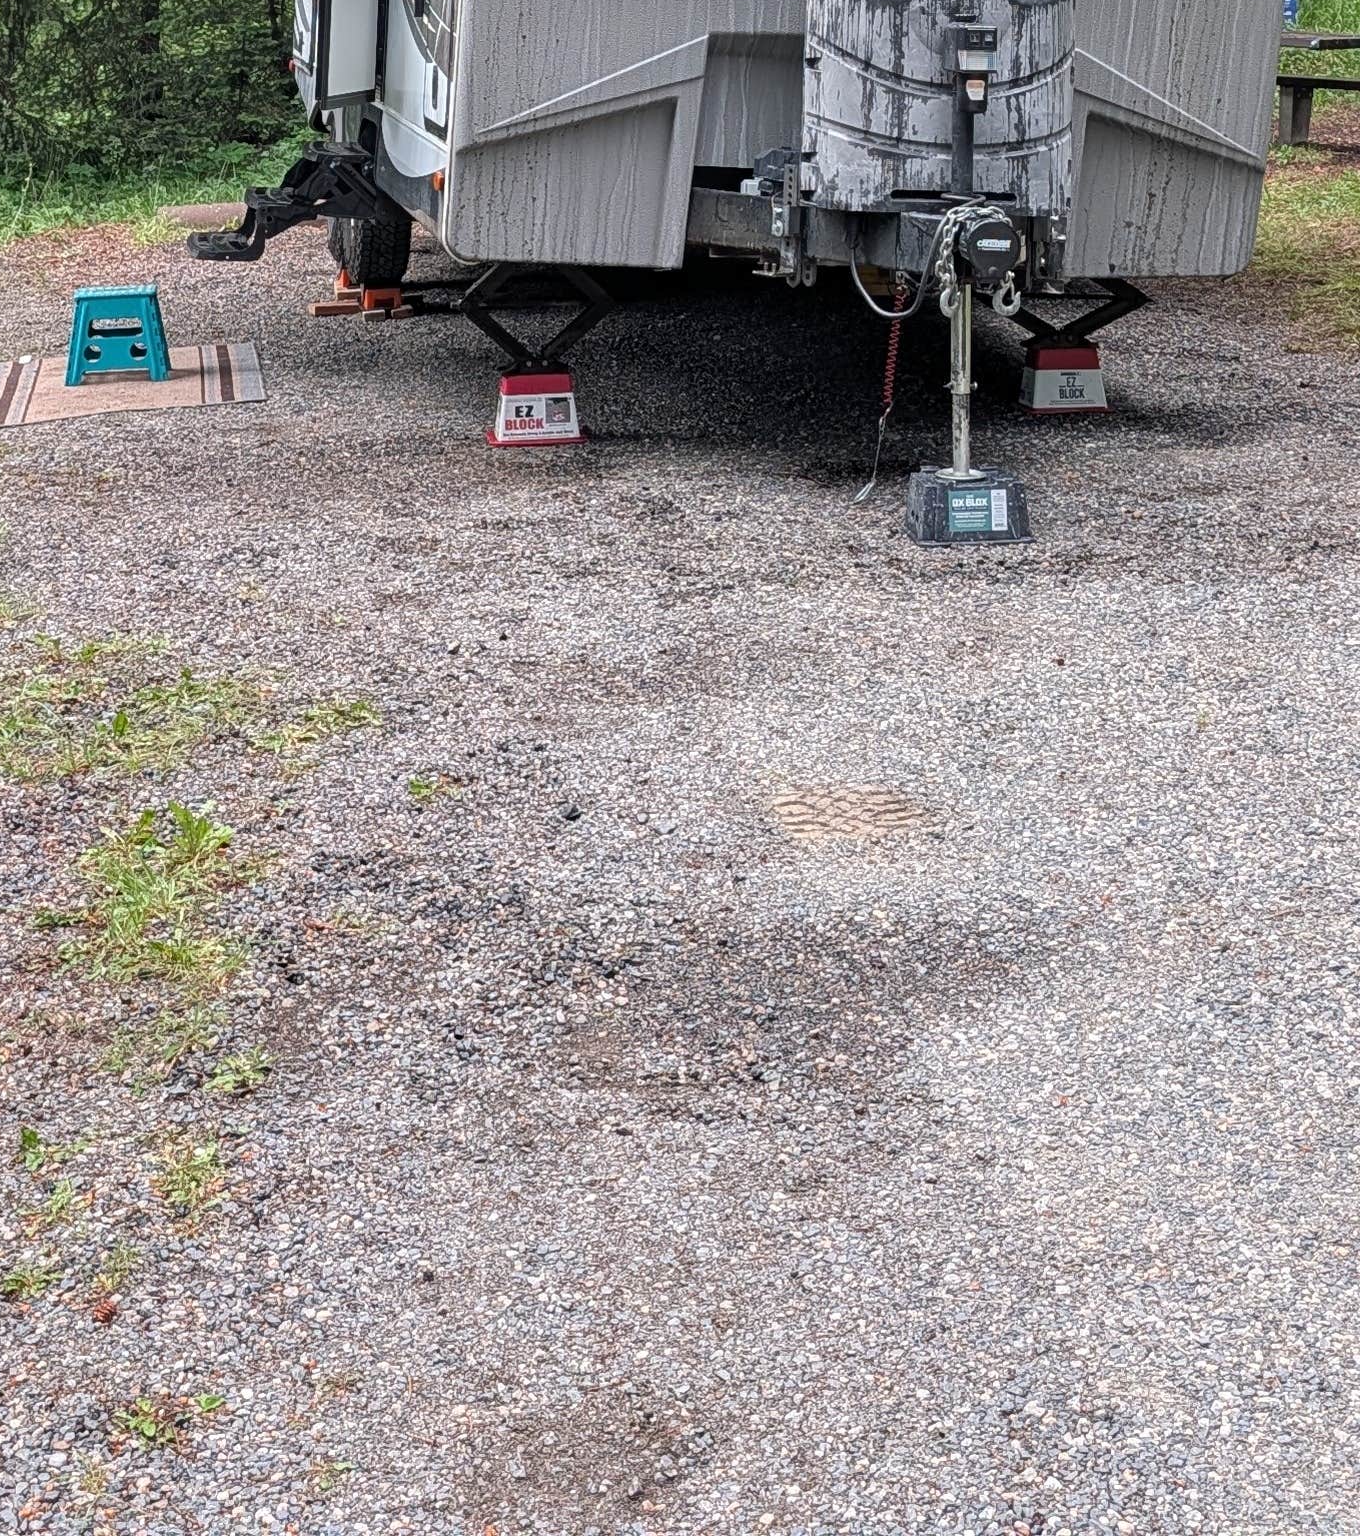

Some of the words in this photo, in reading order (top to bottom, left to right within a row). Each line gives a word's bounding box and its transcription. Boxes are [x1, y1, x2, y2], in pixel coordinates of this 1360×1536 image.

[1066, 376, 1077, 388] EZ
[1059, 388, 1085, 399] BLOCK
[515, 405, 534, 418] EZ
[505, 418, 544, 431] BLOCK
